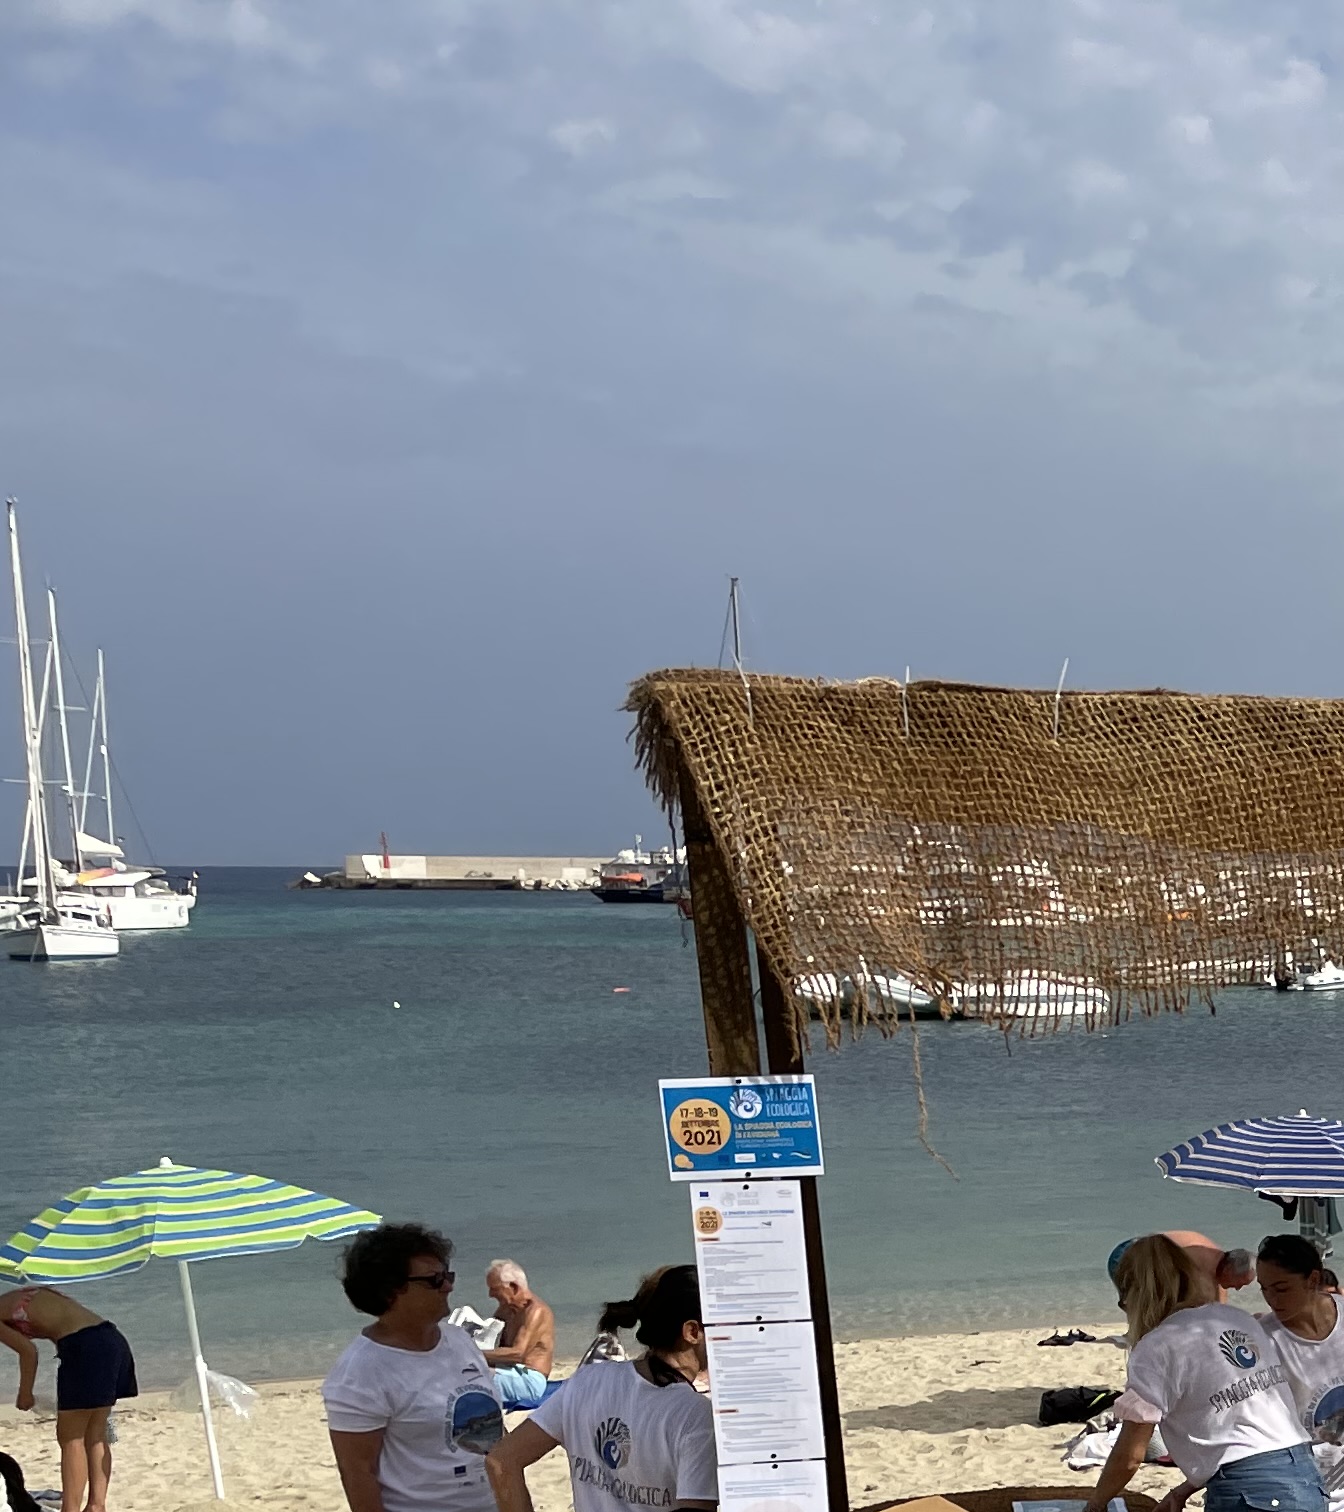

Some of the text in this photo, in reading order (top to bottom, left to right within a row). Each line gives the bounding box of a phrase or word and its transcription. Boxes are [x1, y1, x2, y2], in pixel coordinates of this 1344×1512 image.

[764, 1087, 808, 1102] SPIAGGIA
[766, 1102, 810, 1117] ECOLOGICA
[683, 1129, 722, 1146] 2021
[700, 1220, 718, 1229] 2021
[1209, 1377, 1259, 1414] SPIAGGIA
